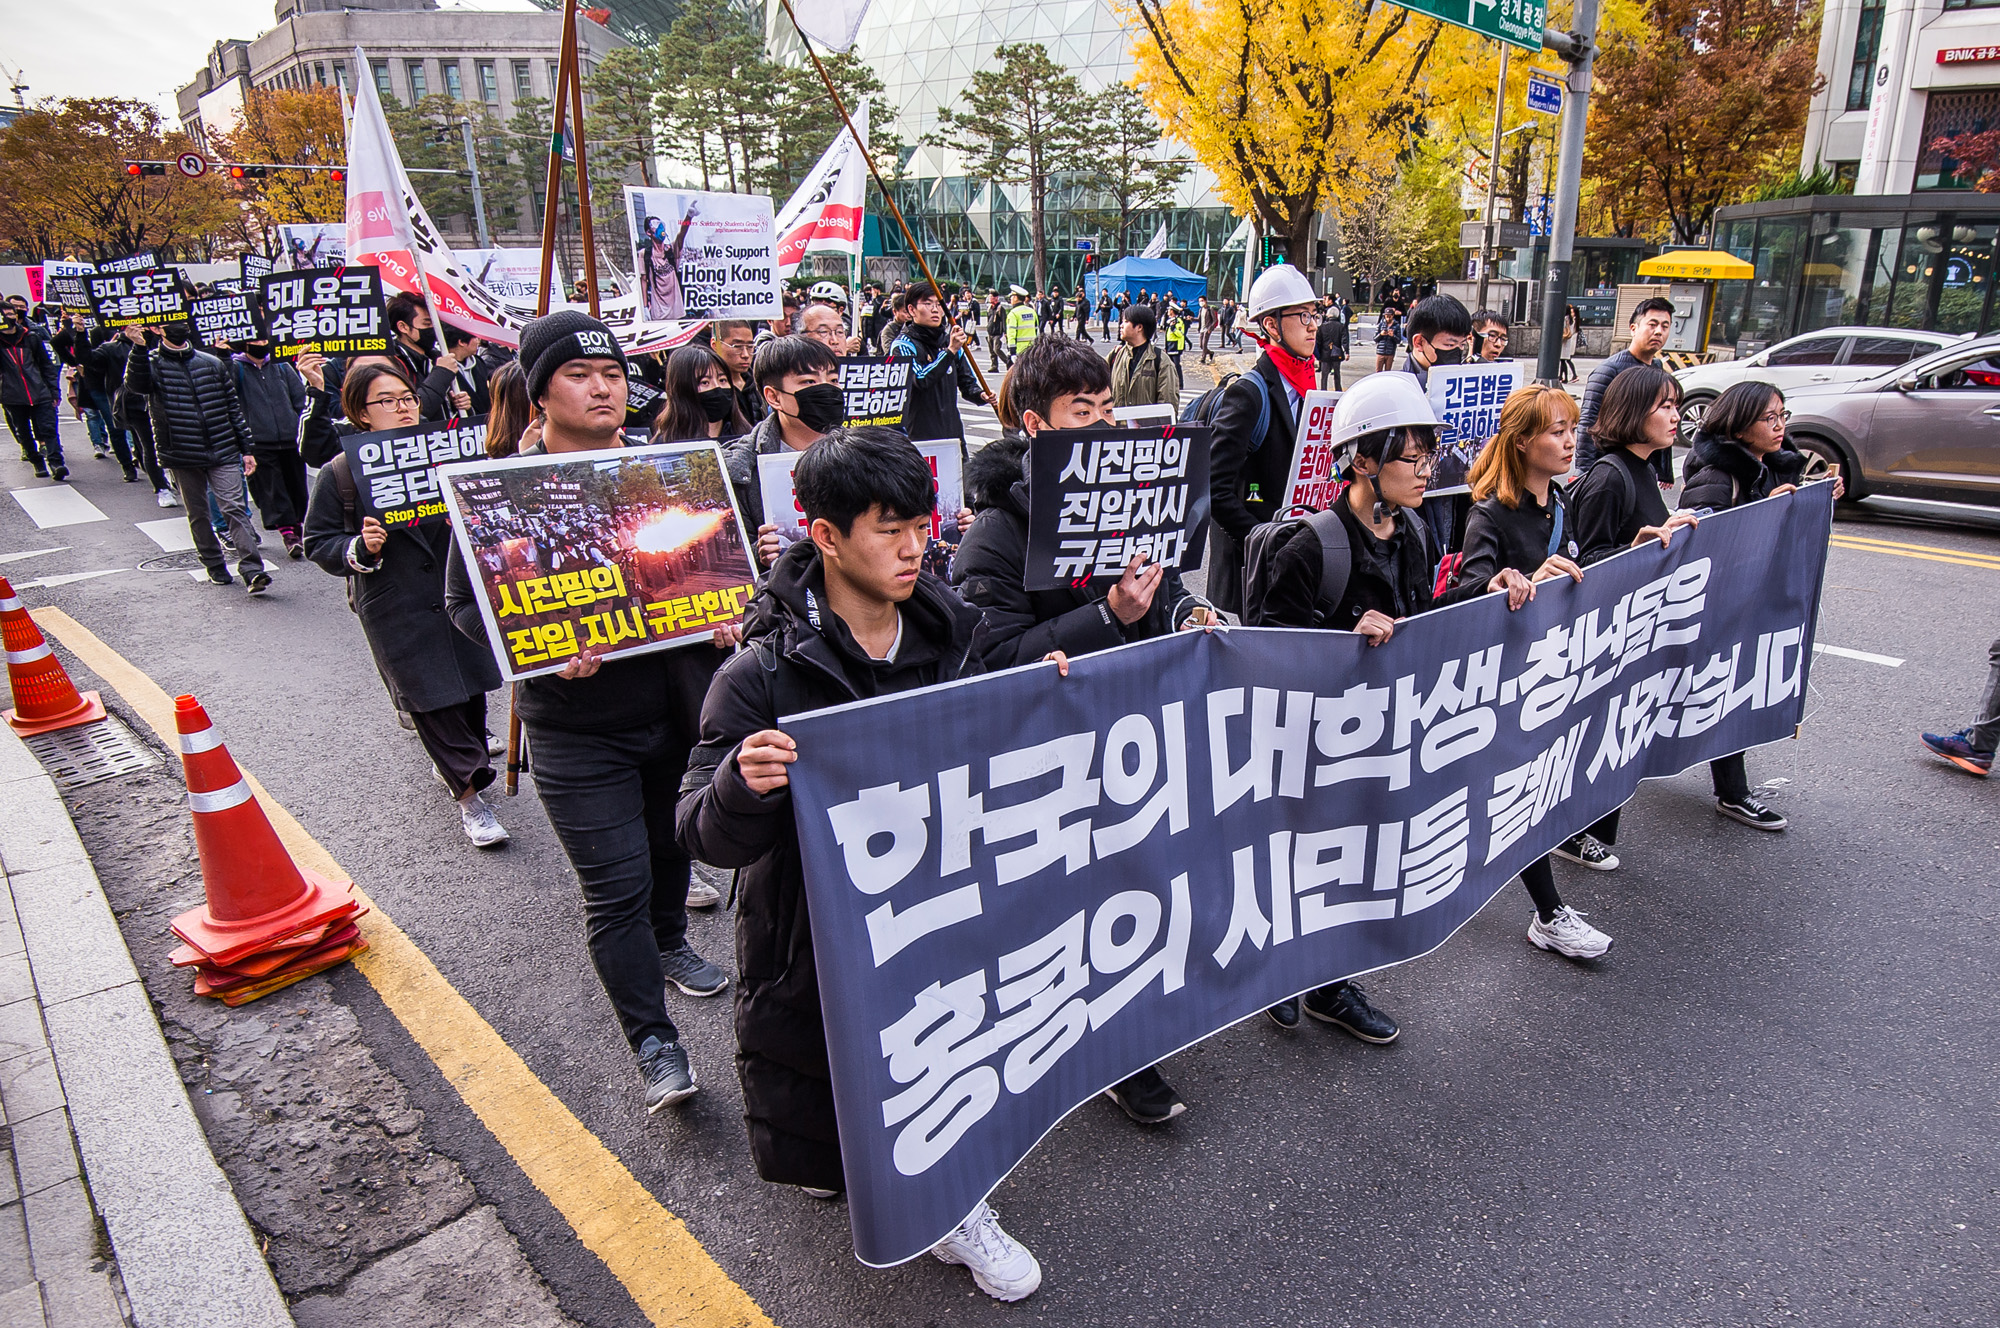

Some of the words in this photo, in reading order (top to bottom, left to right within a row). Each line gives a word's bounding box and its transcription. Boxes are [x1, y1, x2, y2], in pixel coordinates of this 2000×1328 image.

[1499, 16, 1528, 40] Cheonggye
[1527, 26, 1542, 43] Plaza
[1945, 49, 1976, 61] BNK
[704, 245, 722, 258] We
[725, 245, 770, 260] Support
[92, 278, 127, 298] 5대
[133, 274, 174, 295] 요구
[684, 264, 726, 286] Hong
[731, 264, 770, 285] Kong
[99, 293, 183, 317] 수용하라
[267, 278, 305, 311] 5대
[312, 275, 372, 306] 요구
[686, 289, 774, 307] Resistance
[146, 314, 162, 324] NOT
[168, 312, 188, 321] LESS
[191, 296, 247, 316] 시진핑의
[195, 310, 252, 331] 진압지시
[271, 306, 382, 342] 수용하라
[201, 325, 258, 346] 규탄한다
[275, 346, 281, 357] 5
[324, 340, 347, 352] NOT
[349, 340, 355, 351] 1
[357, 338, 387, 350] LESS
[574, 331, 611, 347] BOY
[583, 347, 613, 355] LONDON
[843, 388, 908, 416] 단하라
[1445, 374, 1513, 410] 긴급법을
[358, 424, 488, 476] 인권침해
[1059, 438, 1191, 484] 시진핑의
[1298, 444, 1333, 480] 침해
[385, 509, 416, 524] Stop
[1057, 484, 1189, 533] 진압지시
[1053, 529, 1188, 578] 규탄한다
[498, 564, 627, 617] 시진핑의
[507, 620, 580, 666] 진입
[580, 605, 647, 646] 지시
[826, 700, 1190, 968] 한국의
[880, 872, 1193, 1176] 홍콩의
[1212, 786, 1469, 969] 시민들
[1484, 716, 1591, 866] 곁에
